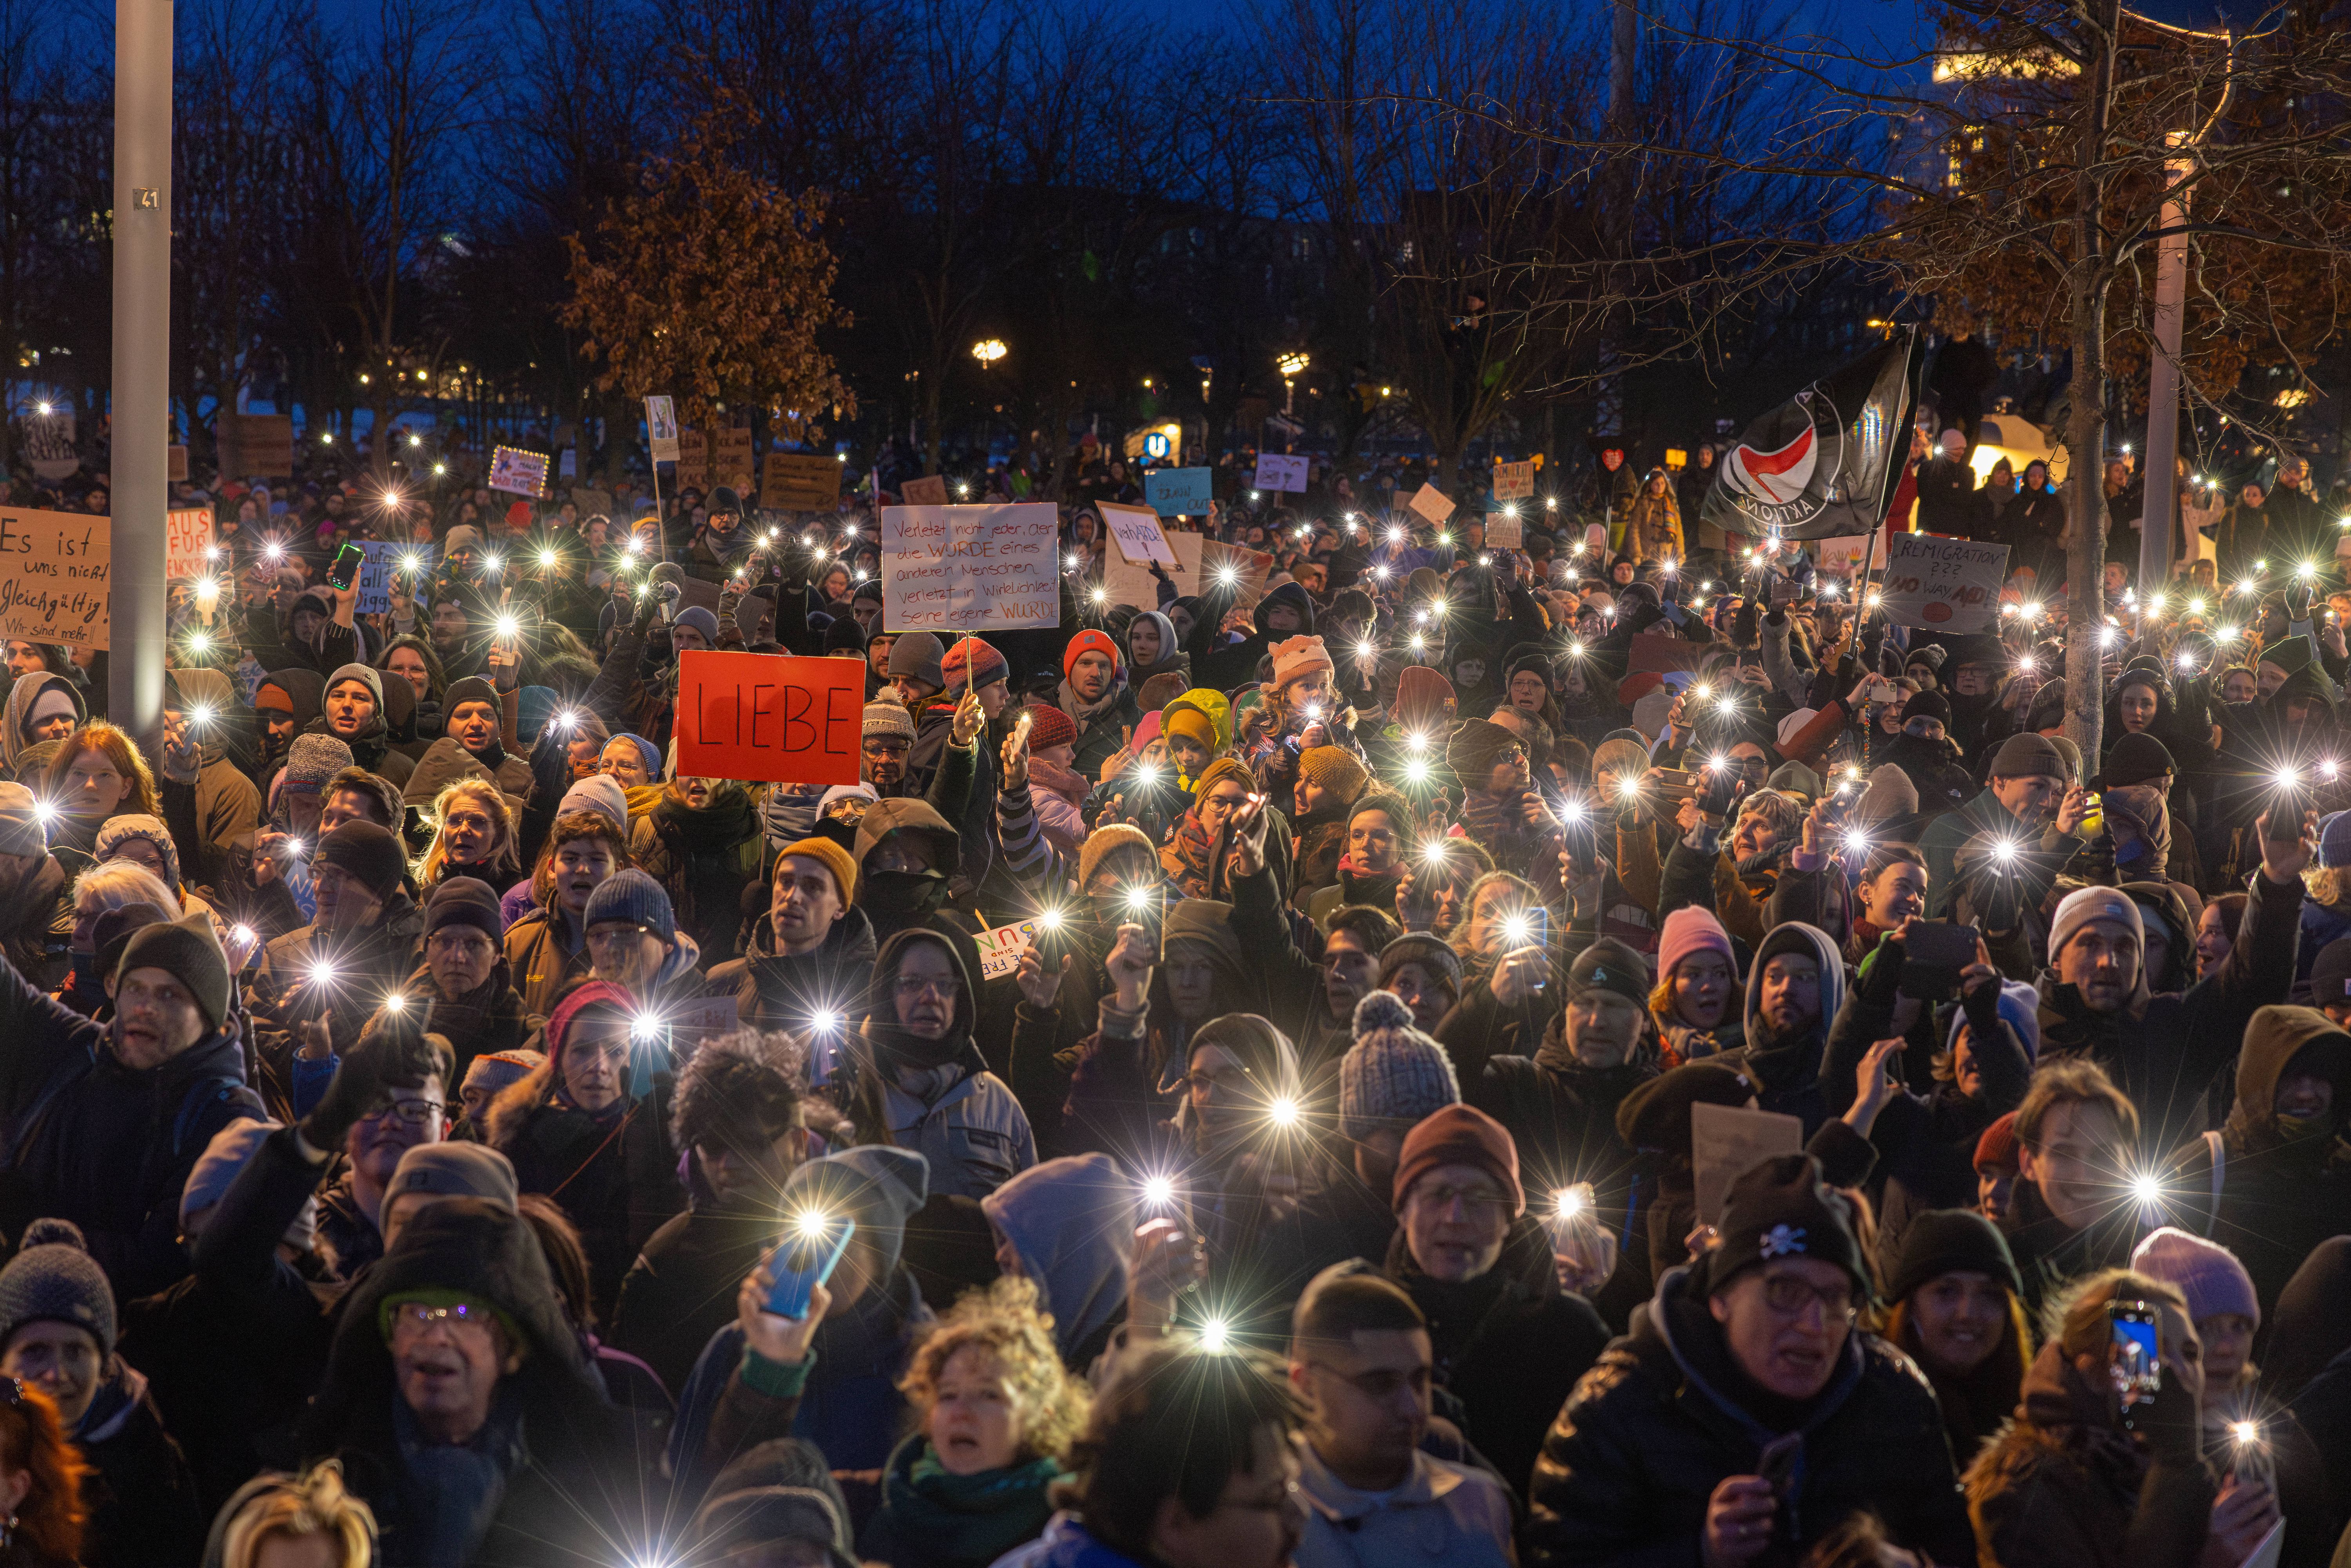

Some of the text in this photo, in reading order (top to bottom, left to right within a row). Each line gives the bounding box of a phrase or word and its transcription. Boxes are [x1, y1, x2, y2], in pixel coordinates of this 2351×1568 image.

[142, 191, 157, 207] 41
[1148, 435, 1166, 457] U
[0, 518, 92, 556] Es ist
[894, 520, 946, 538] Verletzt
[955, 521, 985, 536] nicht
[1029, 523, 1054, 536] der
[898, 547, 922, 559] die
[1000, 542, 1040, 555] eines
[24, 561, 109, 581] uns nicht
[360, 568, 382, 588] all
[897, 562, 1040, 581] anderen Menschen
[1931, 561, 1962, 579] ???
[964, 588, 975, 599] in
[982, 578, 1056, 597] Wirklichkeit
[1889, 576, 1919, 593] NO
[950, 608, 1000, 625] eigene
[5, 617, 27, 634] Wir
[30, 624, 58, 636] sind
[698, 683, 853, 755] LIEBE
